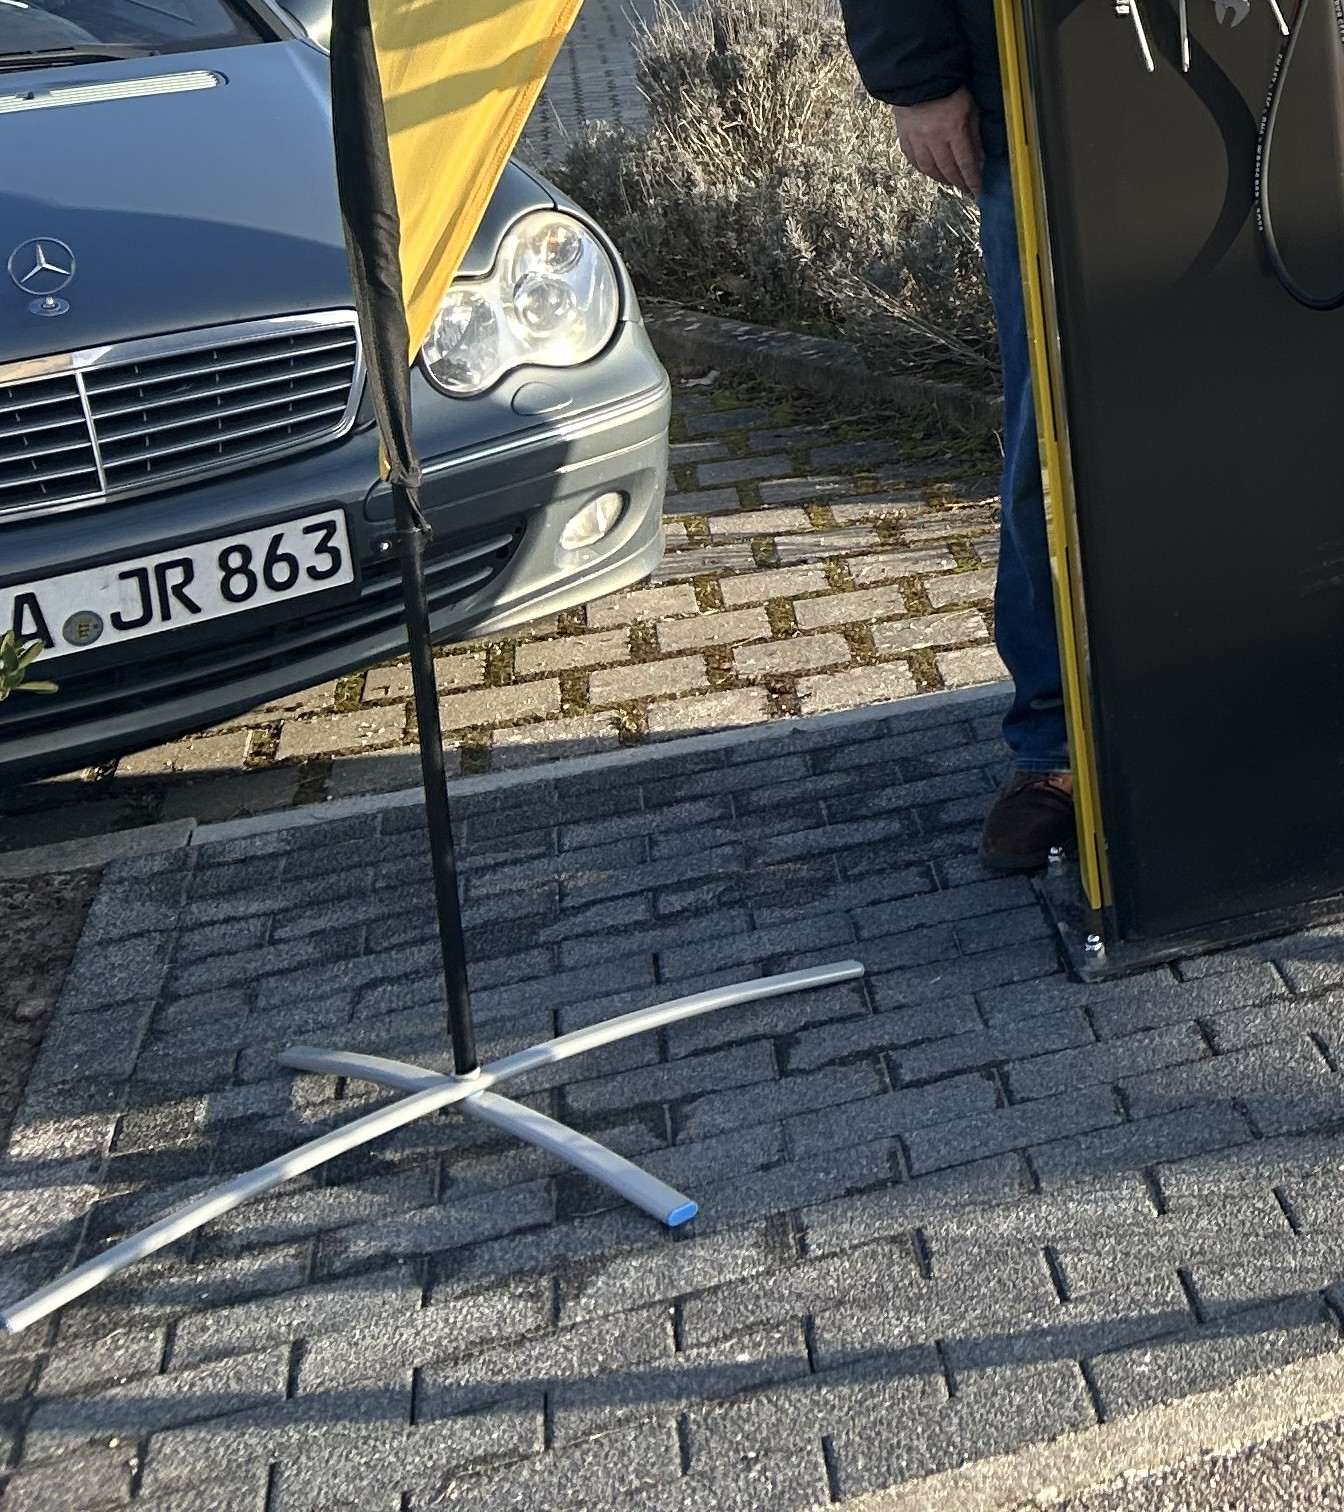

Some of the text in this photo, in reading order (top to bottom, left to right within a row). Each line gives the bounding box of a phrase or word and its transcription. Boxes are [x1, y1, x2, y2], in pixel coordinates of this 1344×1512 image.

[13, 520, 342, 648] A JR 863
